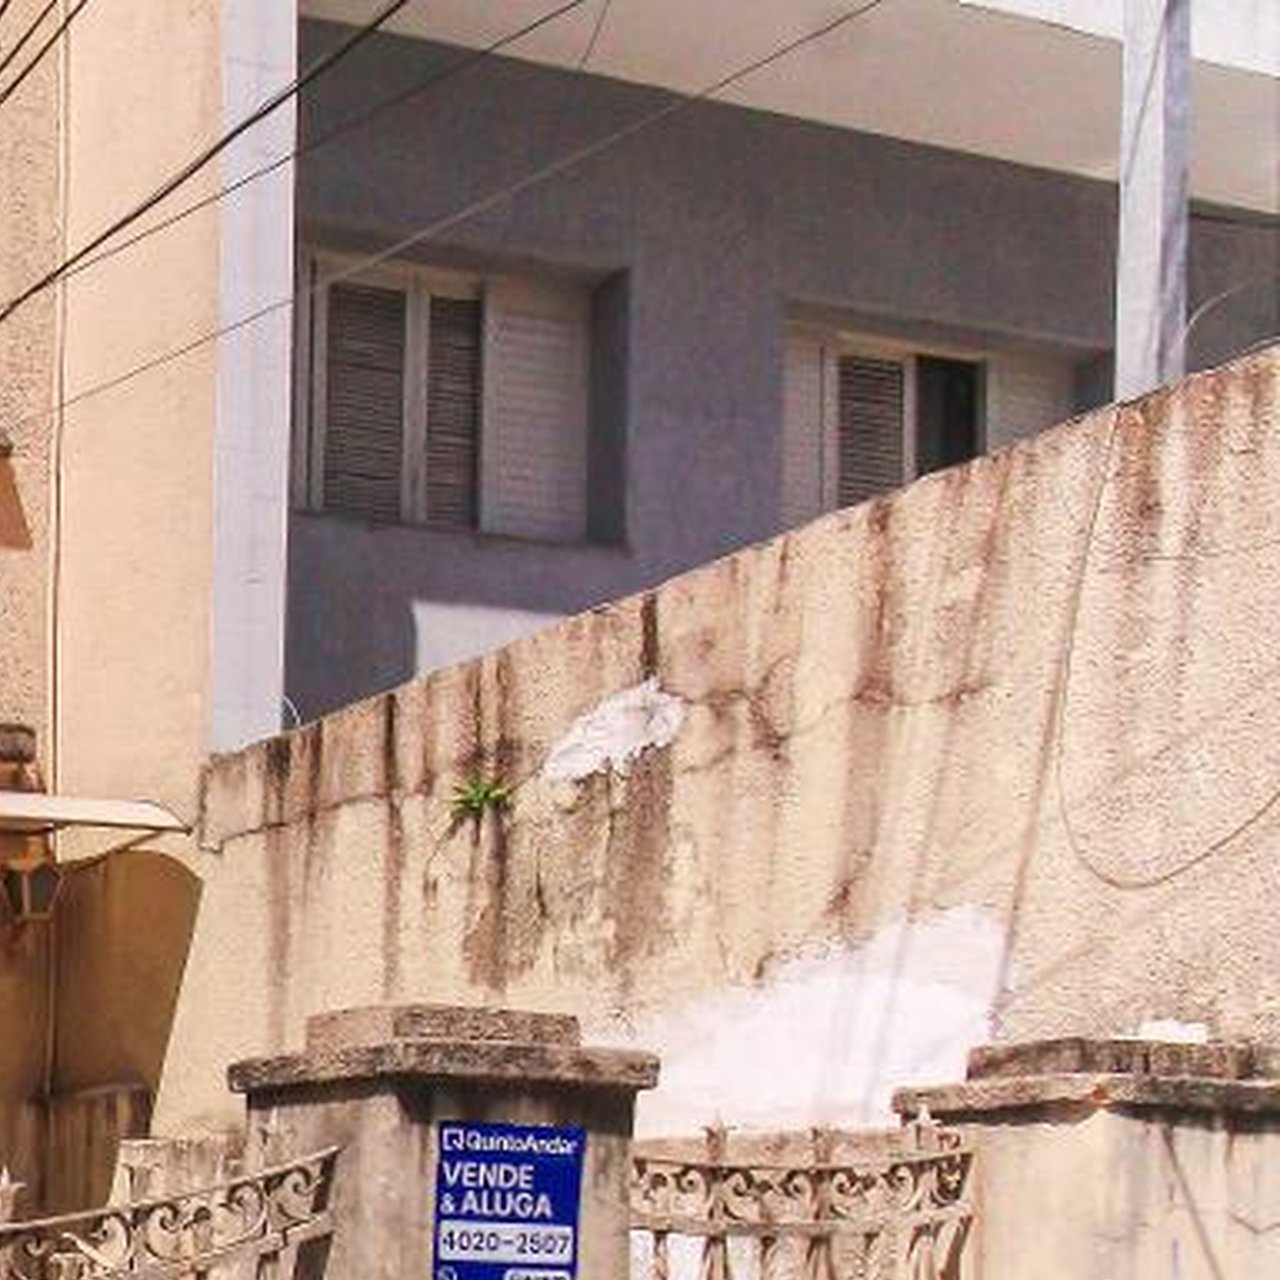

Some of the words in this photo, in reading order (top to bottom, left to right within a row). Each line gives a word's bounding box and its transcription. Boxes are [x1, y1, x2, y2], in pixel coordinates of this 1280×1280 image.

[443, 1161, 535, 1188] VENDE
[441, 1193, 455, 1215] &
[461, 1190, 553, 1218] ALUGA
[443, 1230, 571, 1255] 4020-2507
